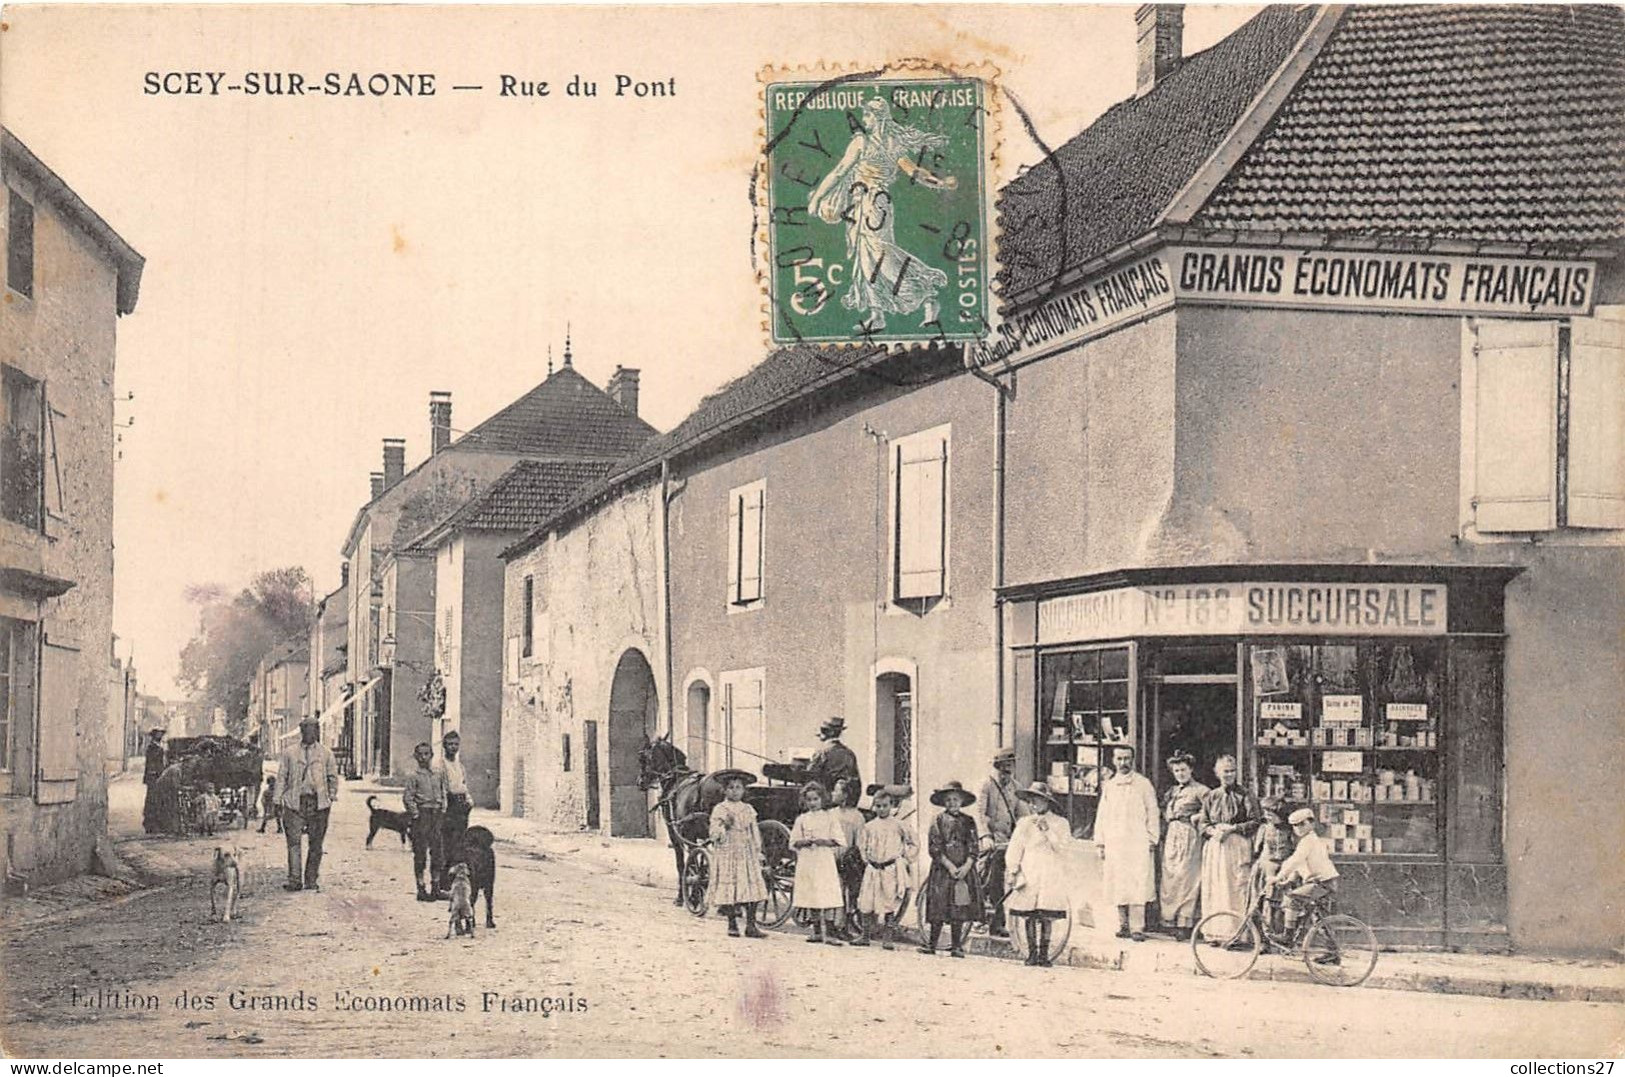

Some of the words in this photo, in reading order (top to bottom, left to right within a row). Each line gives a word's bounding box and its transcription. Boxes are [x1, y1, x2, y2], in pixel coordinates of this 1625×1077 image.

[1094, 257, 1171, 318] FRANÇAIS
[1180, 252, 1285, 294] GRANDS
[1293, 250, 1452, 300] ÉCONOMATS
[1460, 262, 1589, 312] FRANÇAIS
[1247, 587, 1437, 626] SUCCURSALE
